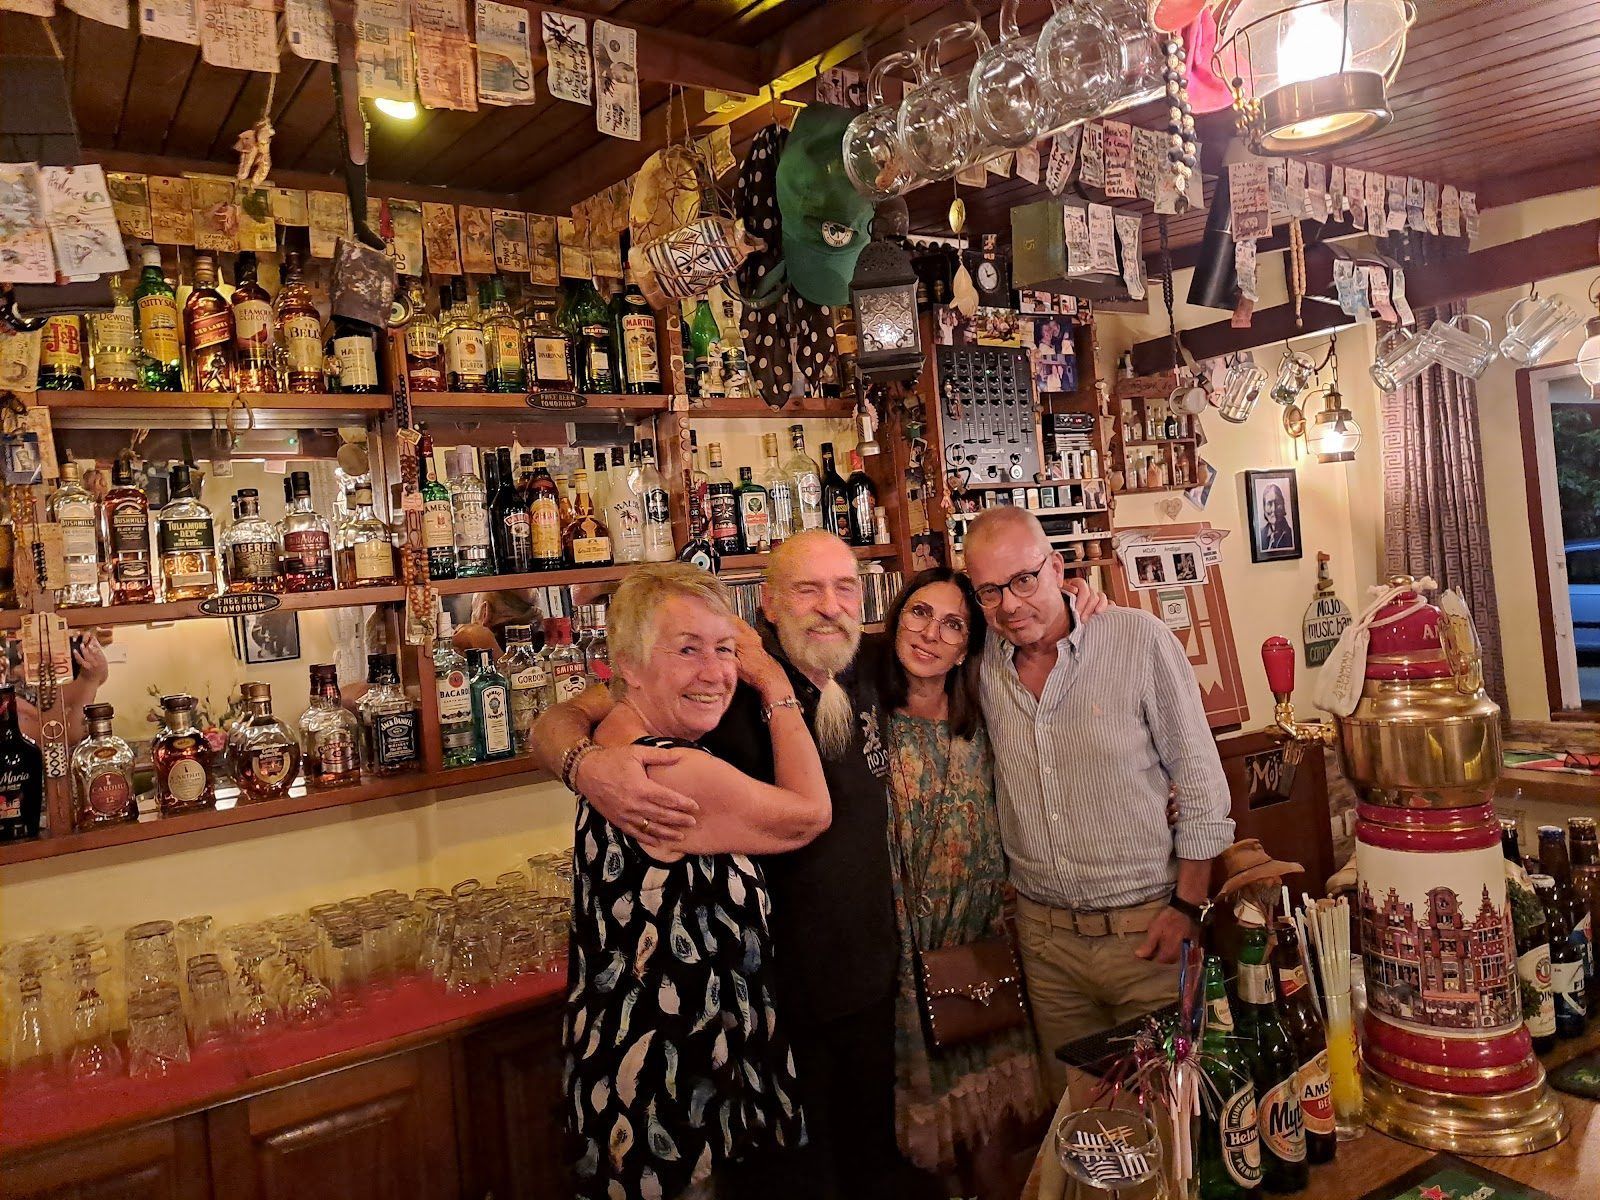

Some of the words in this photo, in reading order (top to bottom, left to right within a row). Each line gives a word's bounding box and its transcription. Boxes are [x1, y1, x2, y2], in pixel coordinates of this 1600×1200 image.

[512, 68, 530, 92] 20
[395, 253, 406, 270] 20
[140, 299, 160, 309] CUTTY
[193, 326, 208, 335] RED
[208, 321, 228, 330] LABEL
[61, 519, 94, 527] BUSHMILLS
[114, 516, 146, 524] BUSHMILLS
[167, 521, 208, 531] TULLAMORE
[217, 597, 240, 606] FREE
[241, 595, 263, 604] BEER
[217, 603, 267, 613] TOMORROW
[380, 719, 394, 731] JACK
